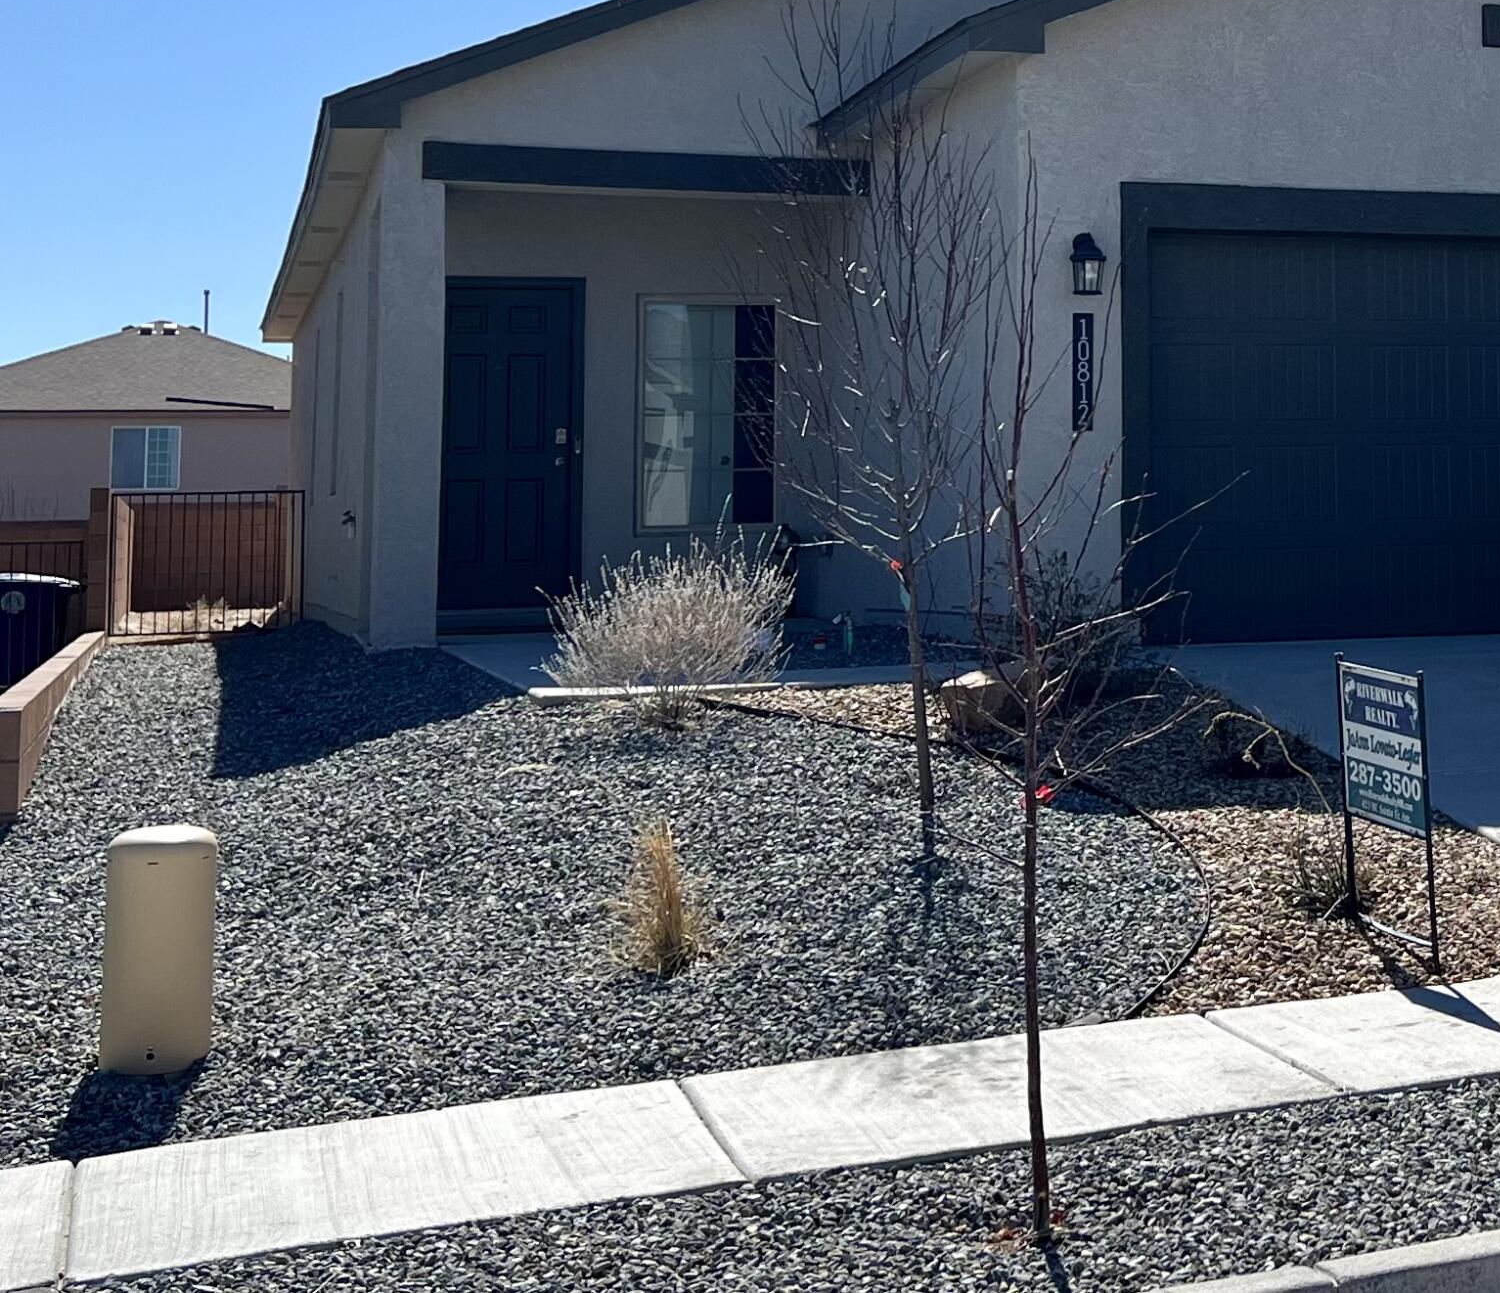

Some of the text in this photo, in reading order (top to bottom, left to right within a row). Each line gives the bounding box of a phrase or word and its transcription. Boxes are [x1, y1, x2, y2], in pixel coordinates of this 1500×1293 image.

[1076, 318, 1091, 427] 10812
[1356, 681, 1405, 708] RIVERWALK
[1349, 760, 1421, 802] 287-3500
